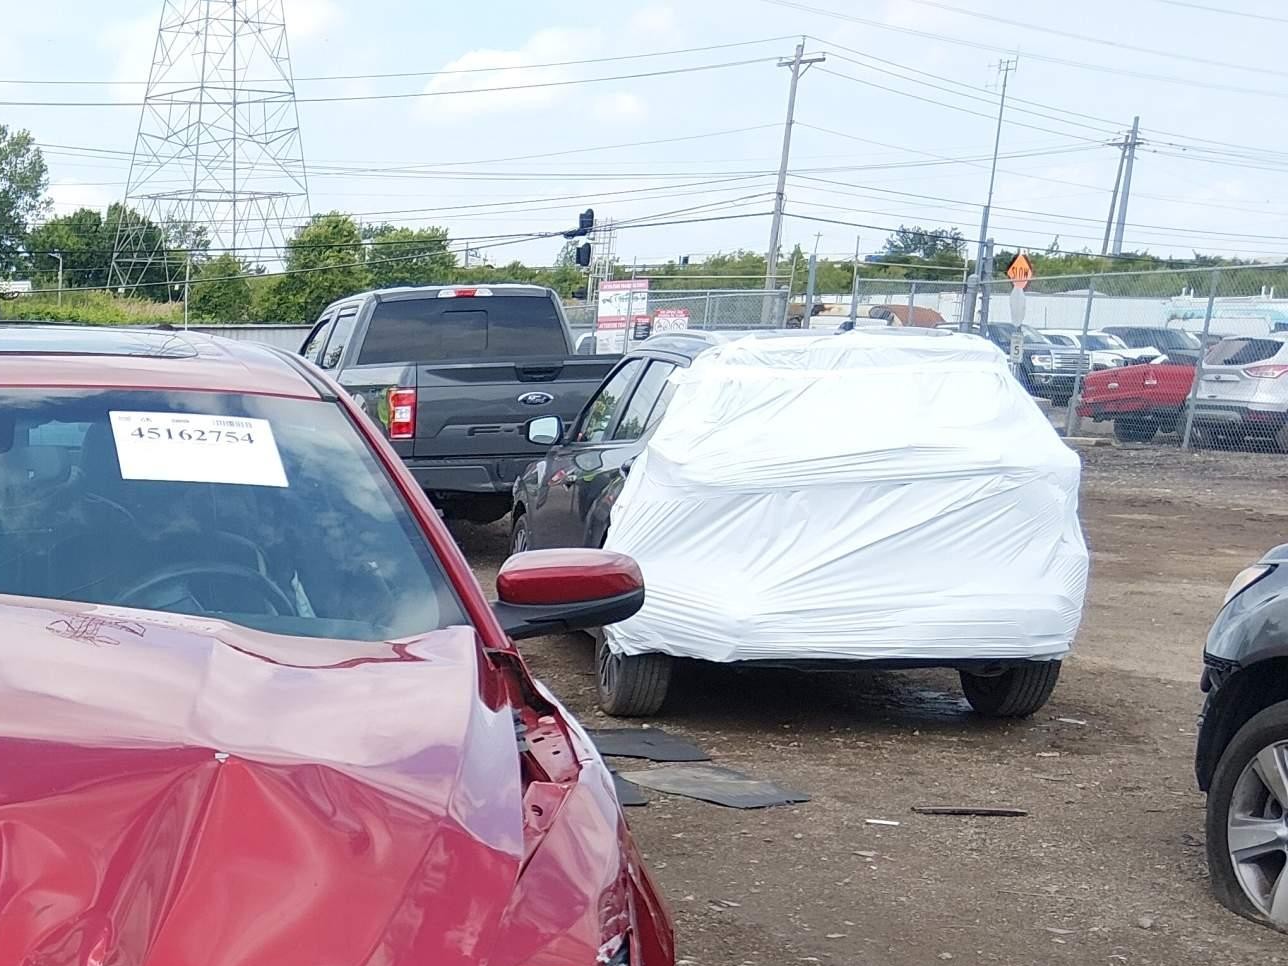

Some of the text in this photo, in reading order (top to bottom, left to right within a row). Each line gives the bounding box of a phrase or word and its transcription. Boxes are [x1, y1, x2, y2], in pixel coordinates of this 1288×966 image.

[1011, 266, 1029, 280] SLOW
[1014, 345, 1020, 355] 5
[130, 426, 255, 445] 45162754
